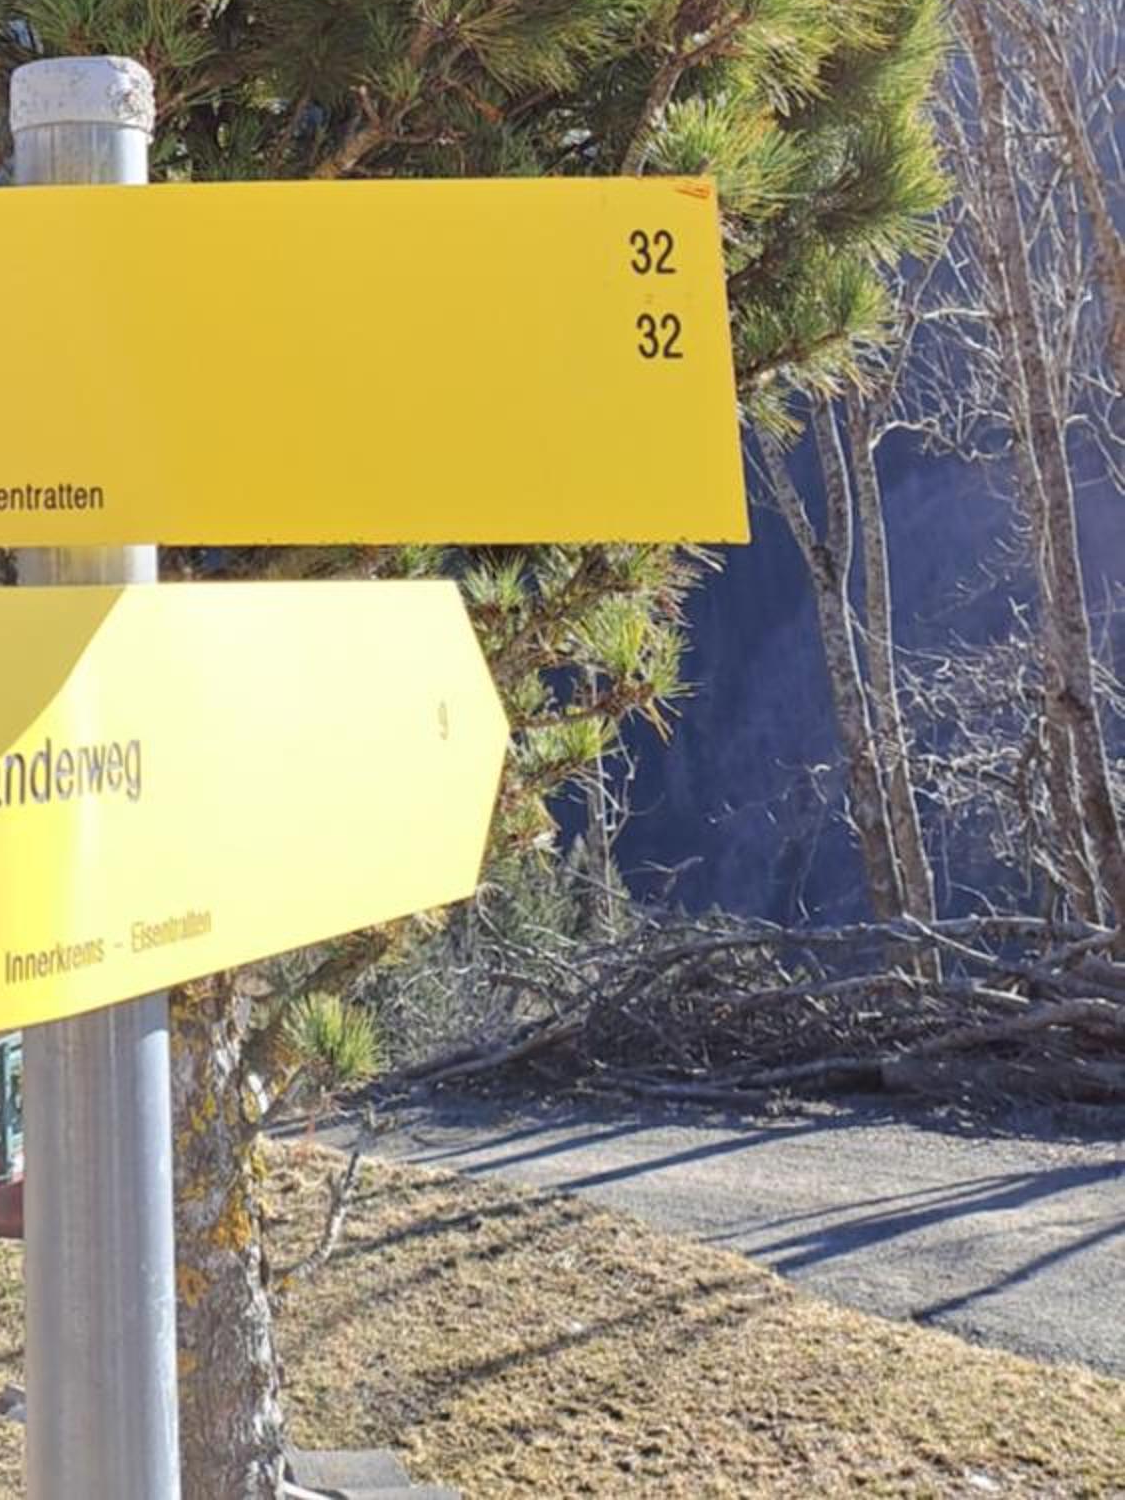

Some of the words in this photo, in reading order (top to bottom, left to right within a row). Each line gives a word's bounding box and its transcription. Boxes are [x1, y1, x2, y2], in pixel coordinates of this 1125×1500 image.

[629, 229, 676, 275] 32
[636, 312, 683, 359] 32
[5, 937, 104, 984] Innerkrems
